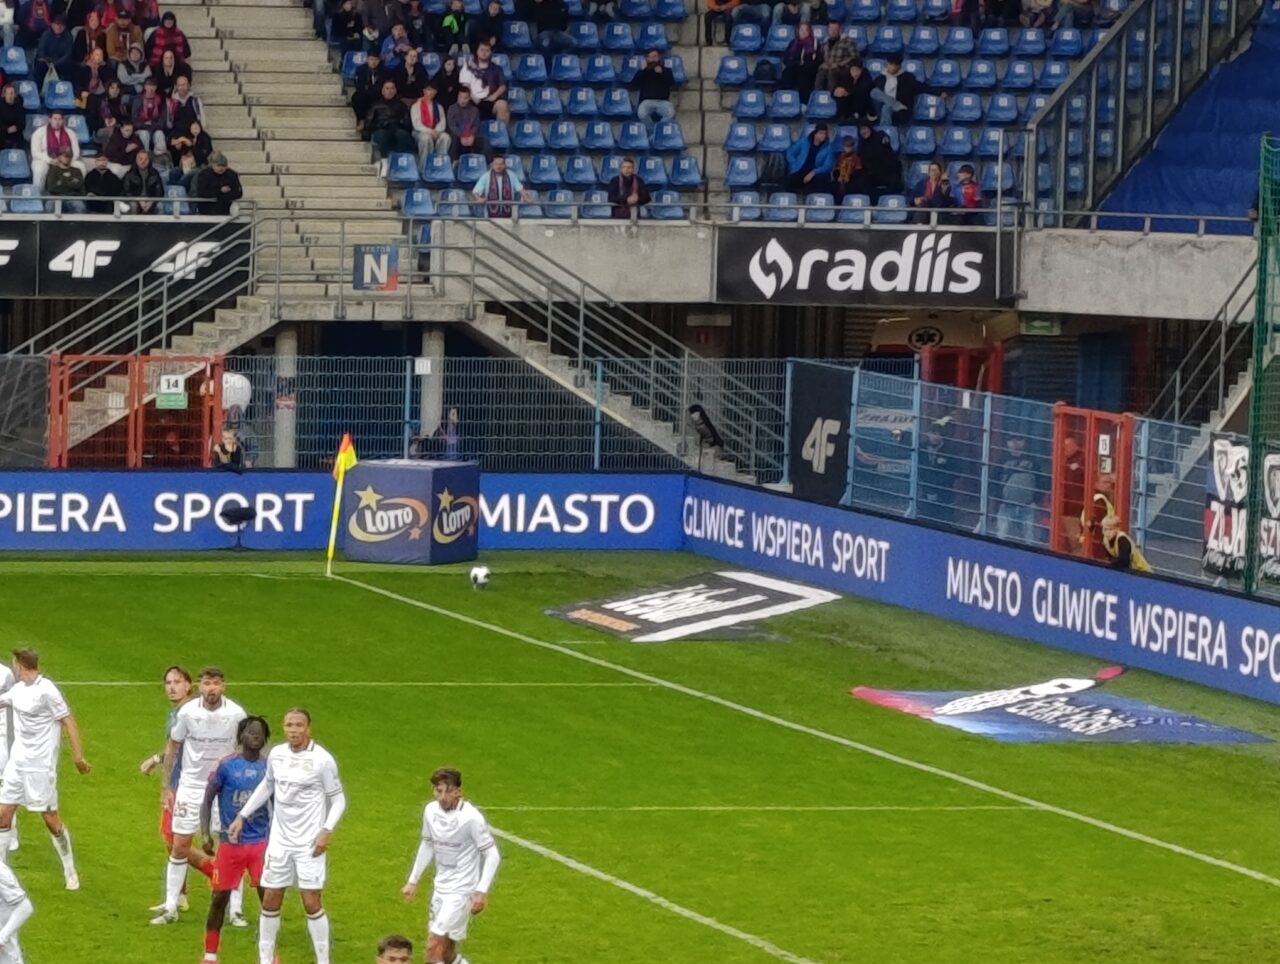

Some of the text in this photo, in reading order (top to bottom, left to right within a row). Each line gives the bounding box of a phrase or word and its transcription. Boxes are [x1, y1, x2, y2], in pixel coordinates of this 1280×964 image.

[47, 239, 121, 278] 4F
[151, 241, 221, 280] 4F
[363, 254, 388, 284] N
[796, 233, 983, 293] radiis
[165, 378, 179, 389] 14
[801, 416, 841, 474] 4F
[153, 492, 314, 533] SPORT
[364, 507, 413, 533] LOTTO
[441, 505, 471, 535] LOTTO
[479, 493, 890, 583] MIASTO GLIWICE WSPIERA SPORT
[946, 556, 1022, 617] MIASTO
[1032, 577, 1118, 641] GLIWICE
[1129, 599, 1228, 669] WSPIERA
